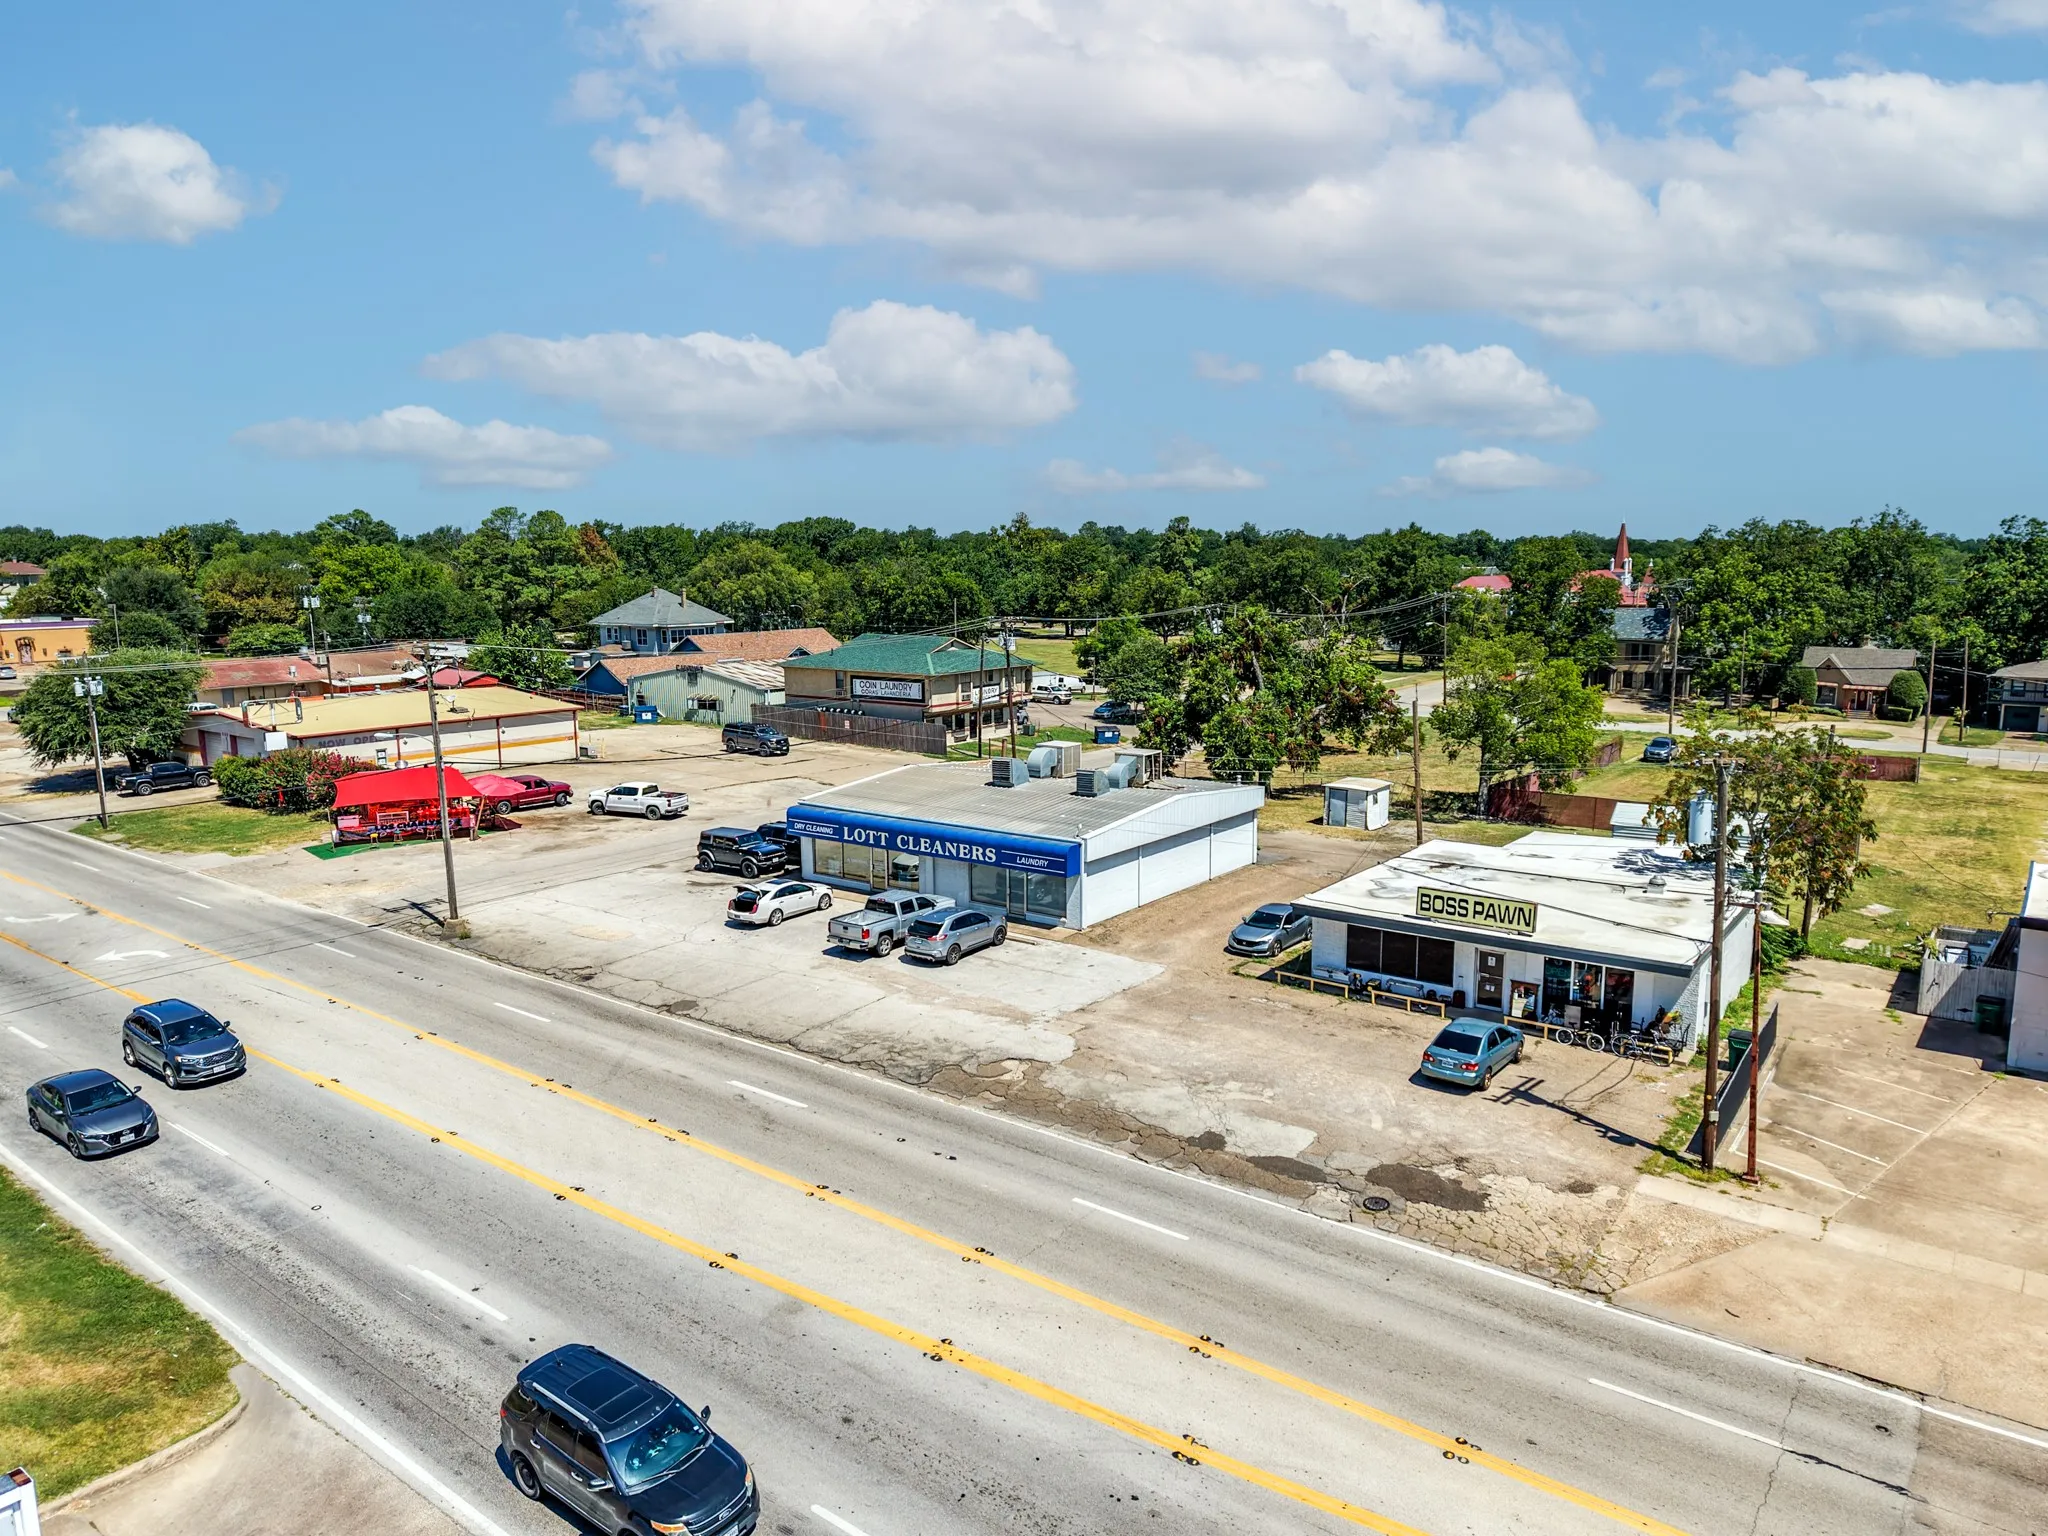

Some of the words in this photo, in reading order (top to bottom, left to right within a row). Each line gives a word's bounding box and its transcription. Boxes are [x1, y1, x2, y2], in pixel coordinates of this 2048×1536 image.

[859, 680, 877, 689] COIN
[880, 681, 913, 692] LAUNDRY
[974, 687, 998, 696] LNDRY
[353, 734, 380, 745] OPE
[794, 822, 806, 830] DRY
[805, 823, 834, 835] CLEANING
[843, 826, 889, 846] LOTT
[896, 834, 997, 863] CLEANERS
[1016, 856, 1049, 868] LAUNDRY
[1420, 892, 1469, 918] BOSS
[1472, 900, 1532, 927] PAWN
